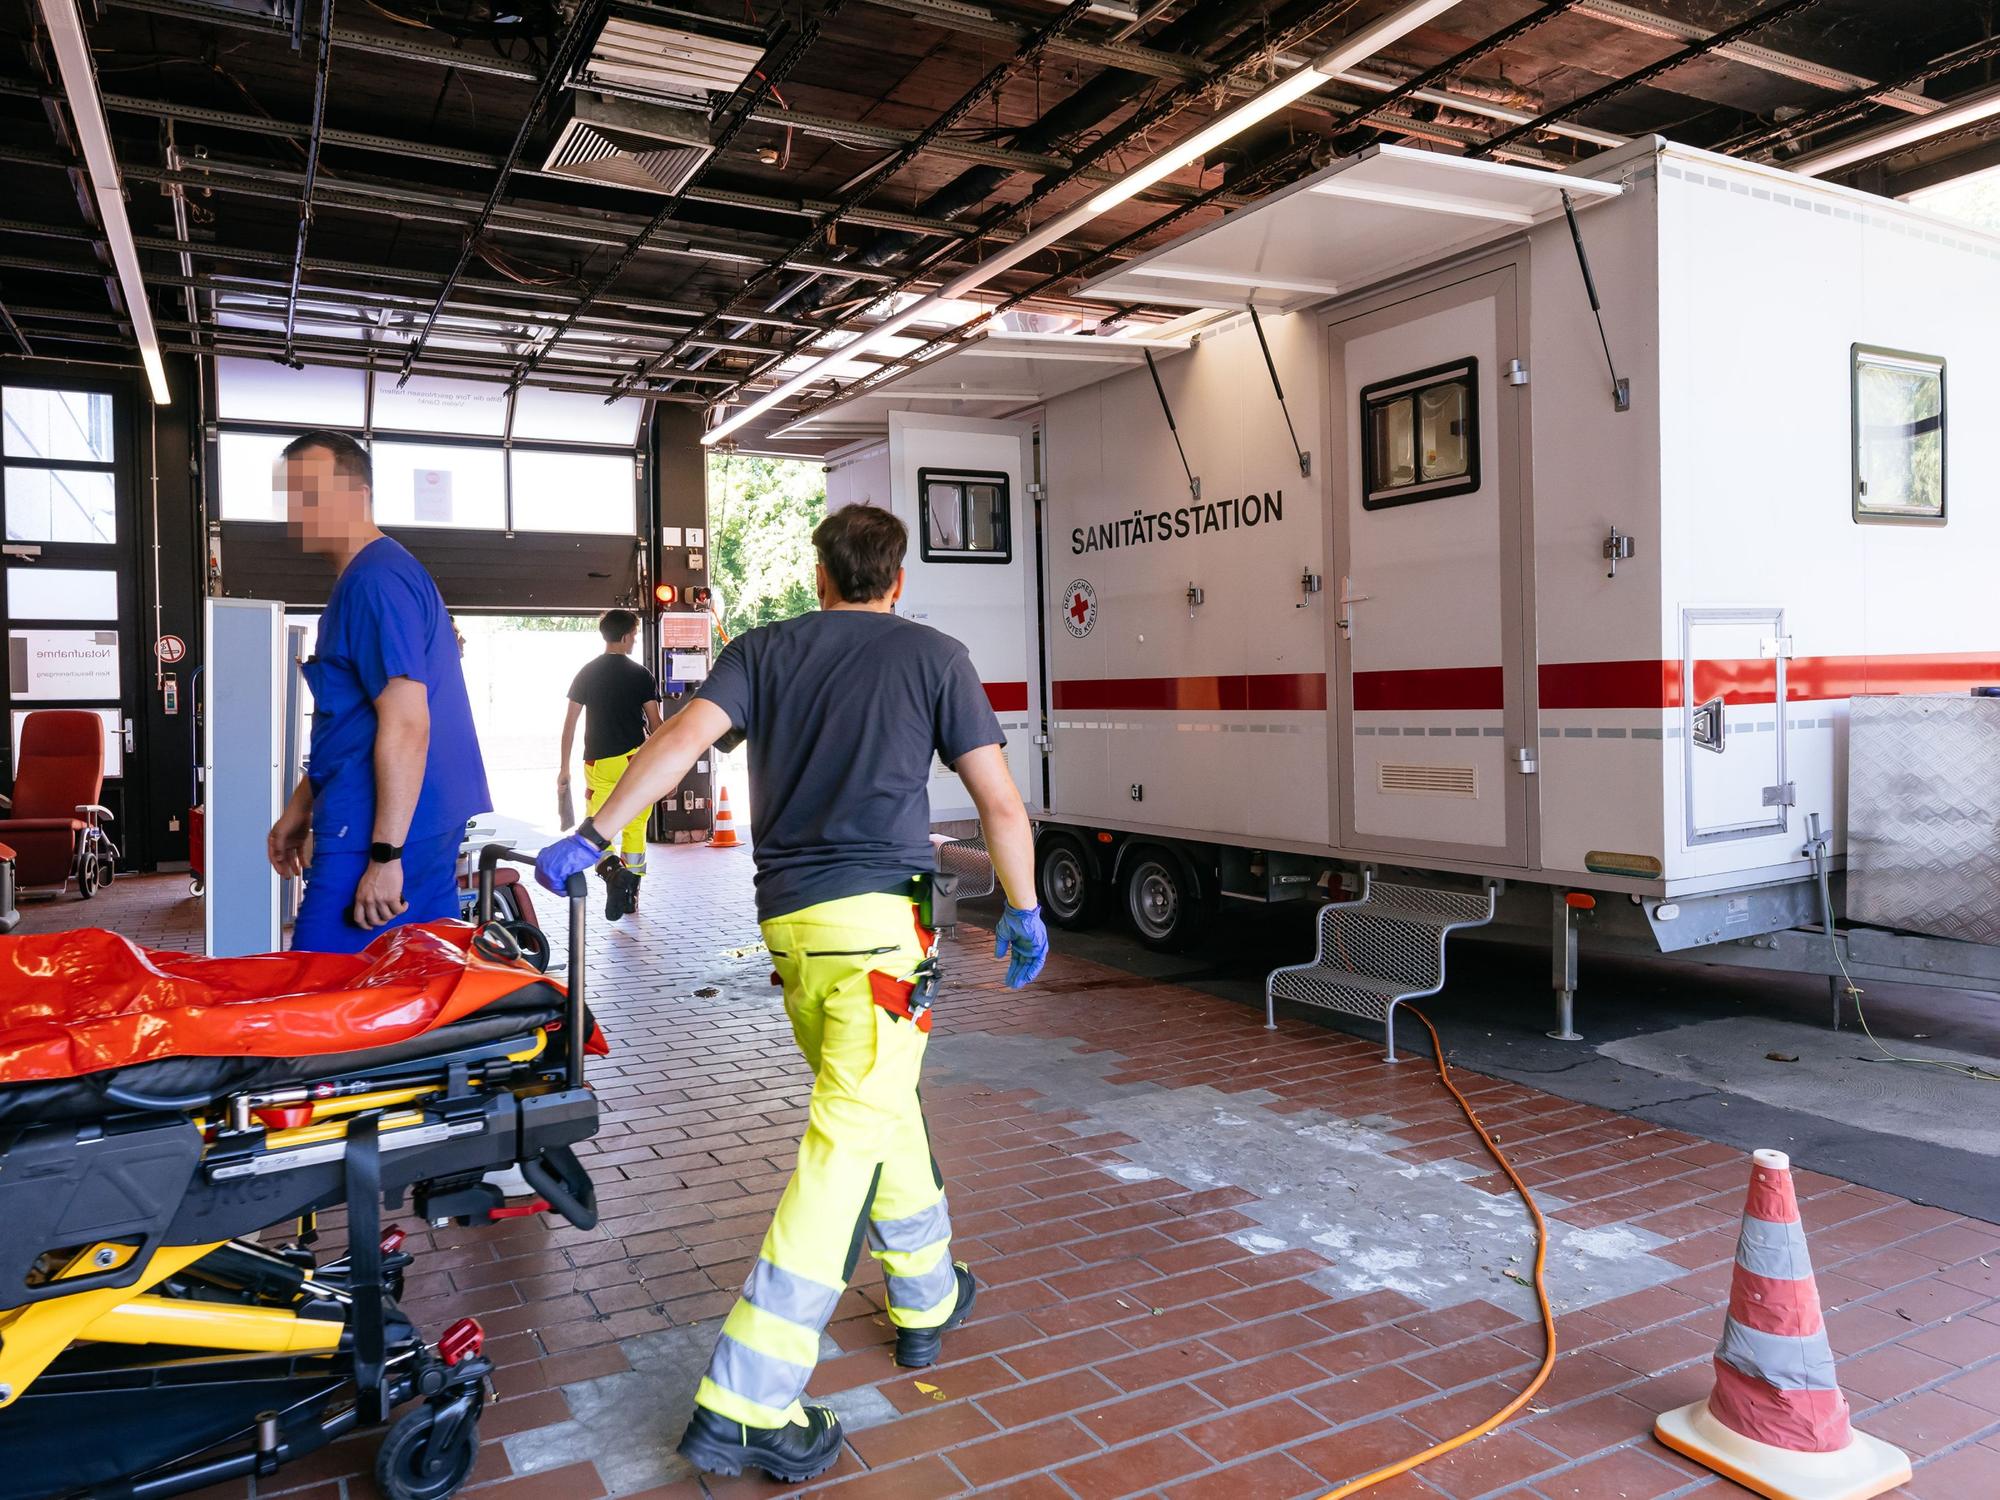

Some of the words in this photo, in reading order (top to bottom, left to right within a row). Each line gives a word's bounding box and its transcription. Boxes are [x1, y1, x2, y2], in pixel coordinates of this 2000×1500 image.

[1071, 490, 1283, 555] SANITÄTSSTATION
[691, 533, 697, 544] 1
[1064, 582, 1092, 609] DEUTSCHES
[1066, 616, 1082, 636] ROTES
[1084, 602, 1096, 633] KREUZ
